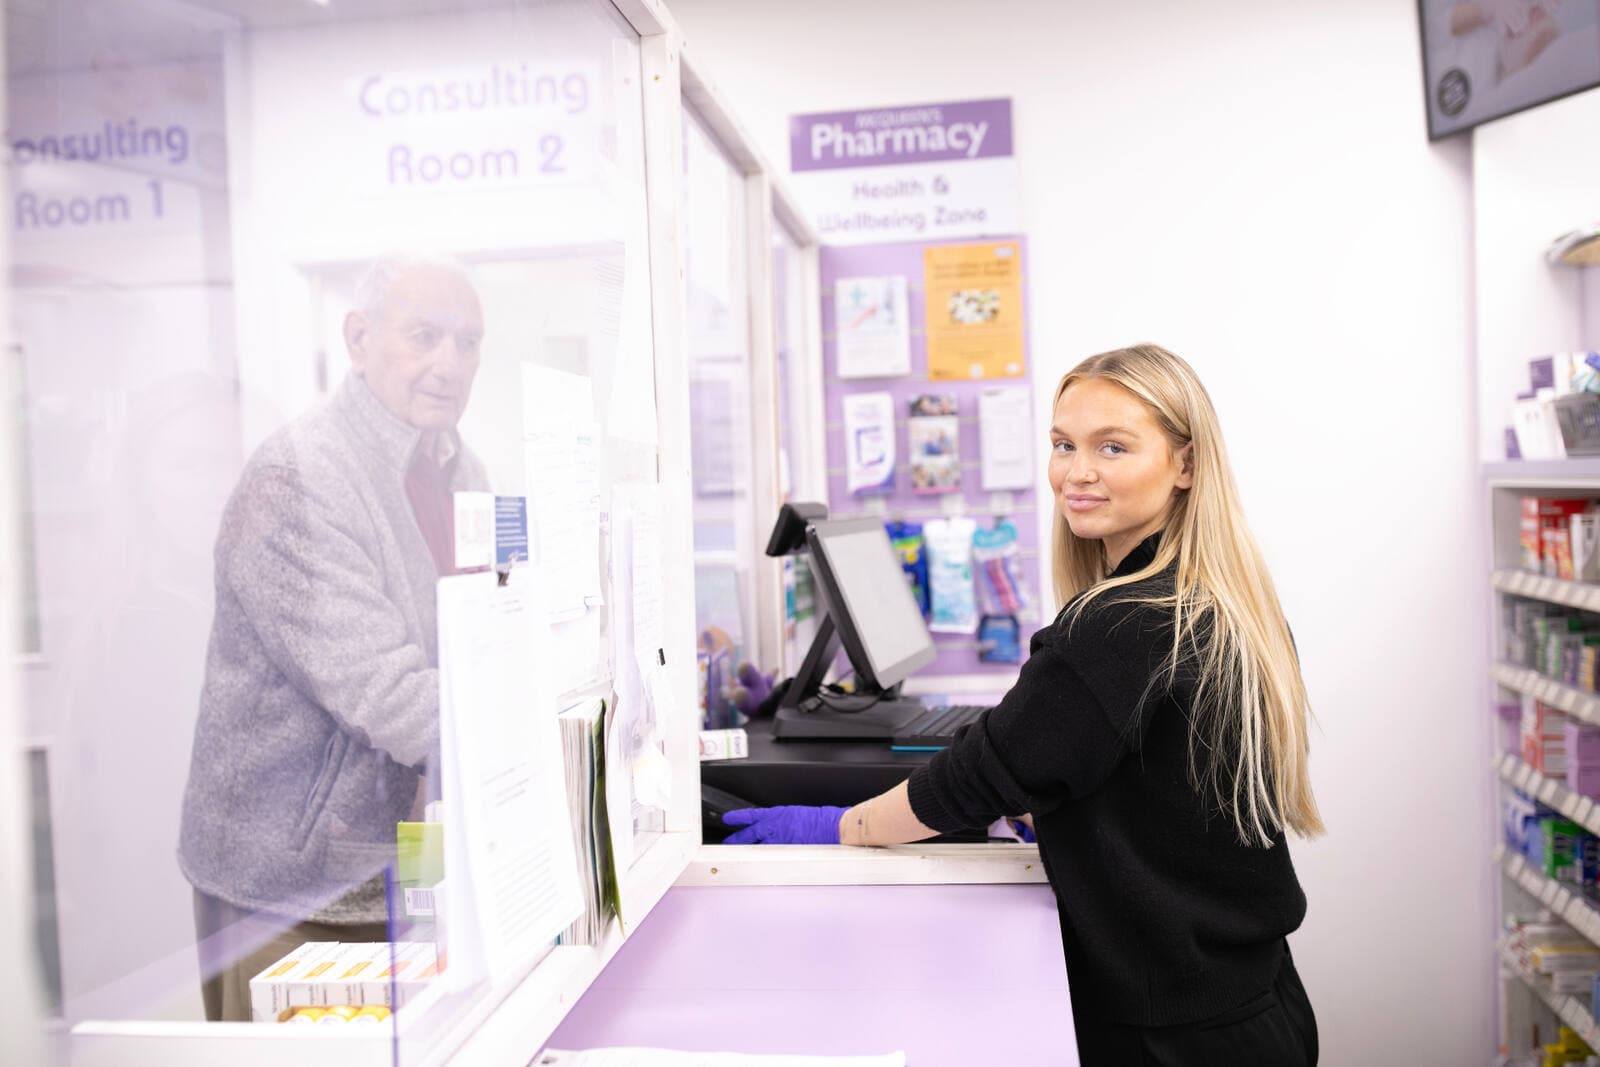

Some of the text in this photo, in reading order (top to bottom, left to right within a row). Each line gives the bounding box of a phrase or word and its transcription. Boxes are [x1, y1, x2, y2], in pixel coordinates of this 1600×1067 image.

[359, 64, 590, 117] Consulting
[6, 120, 190, 165] onsulting
[387, 134, 567, 184] Room 2
[810, 121, 989, 160] Pharmacy
[16, 181, 165, 230] Room 1
[853, 174, 949, 199] Health &
[818, 205, 988, 233] Wellbeing Zone
